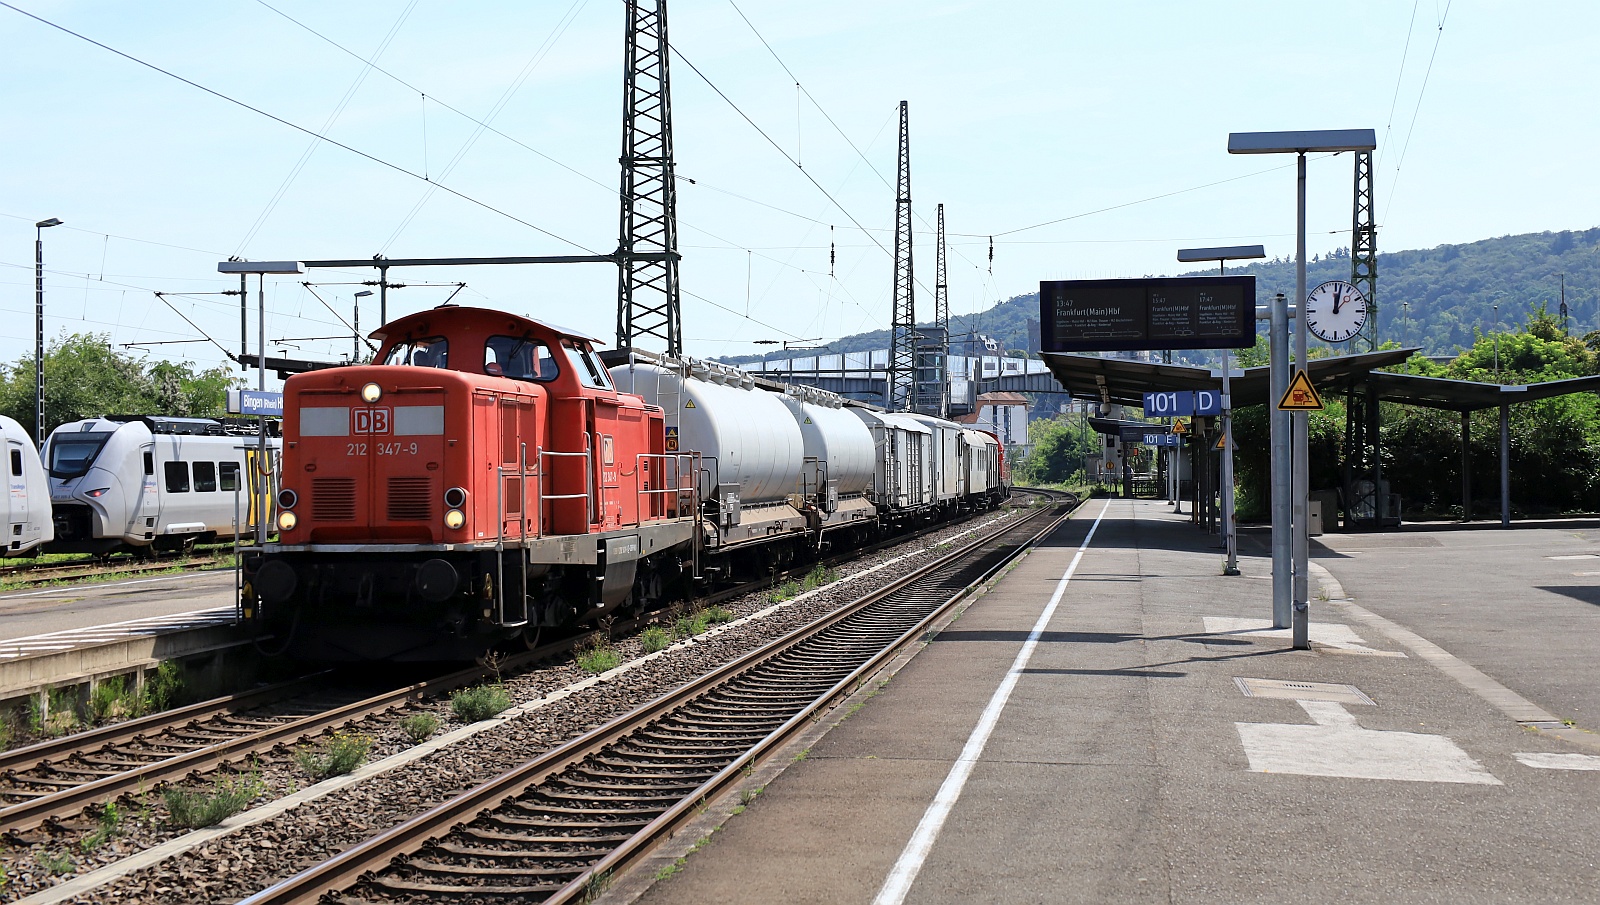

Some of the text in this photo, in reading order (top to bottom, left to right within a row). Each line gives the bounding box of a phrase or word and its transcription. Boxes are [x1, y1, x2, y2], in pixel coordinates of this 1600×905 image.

[243, 394, 263, 411] Bingen
[1147, 392, 1213, 412] 101 D
[355, 411, 387, 431] DB
[1145, 434, 1173, 444] 101 E
[347, 442, 418, 456] 212 347-9
